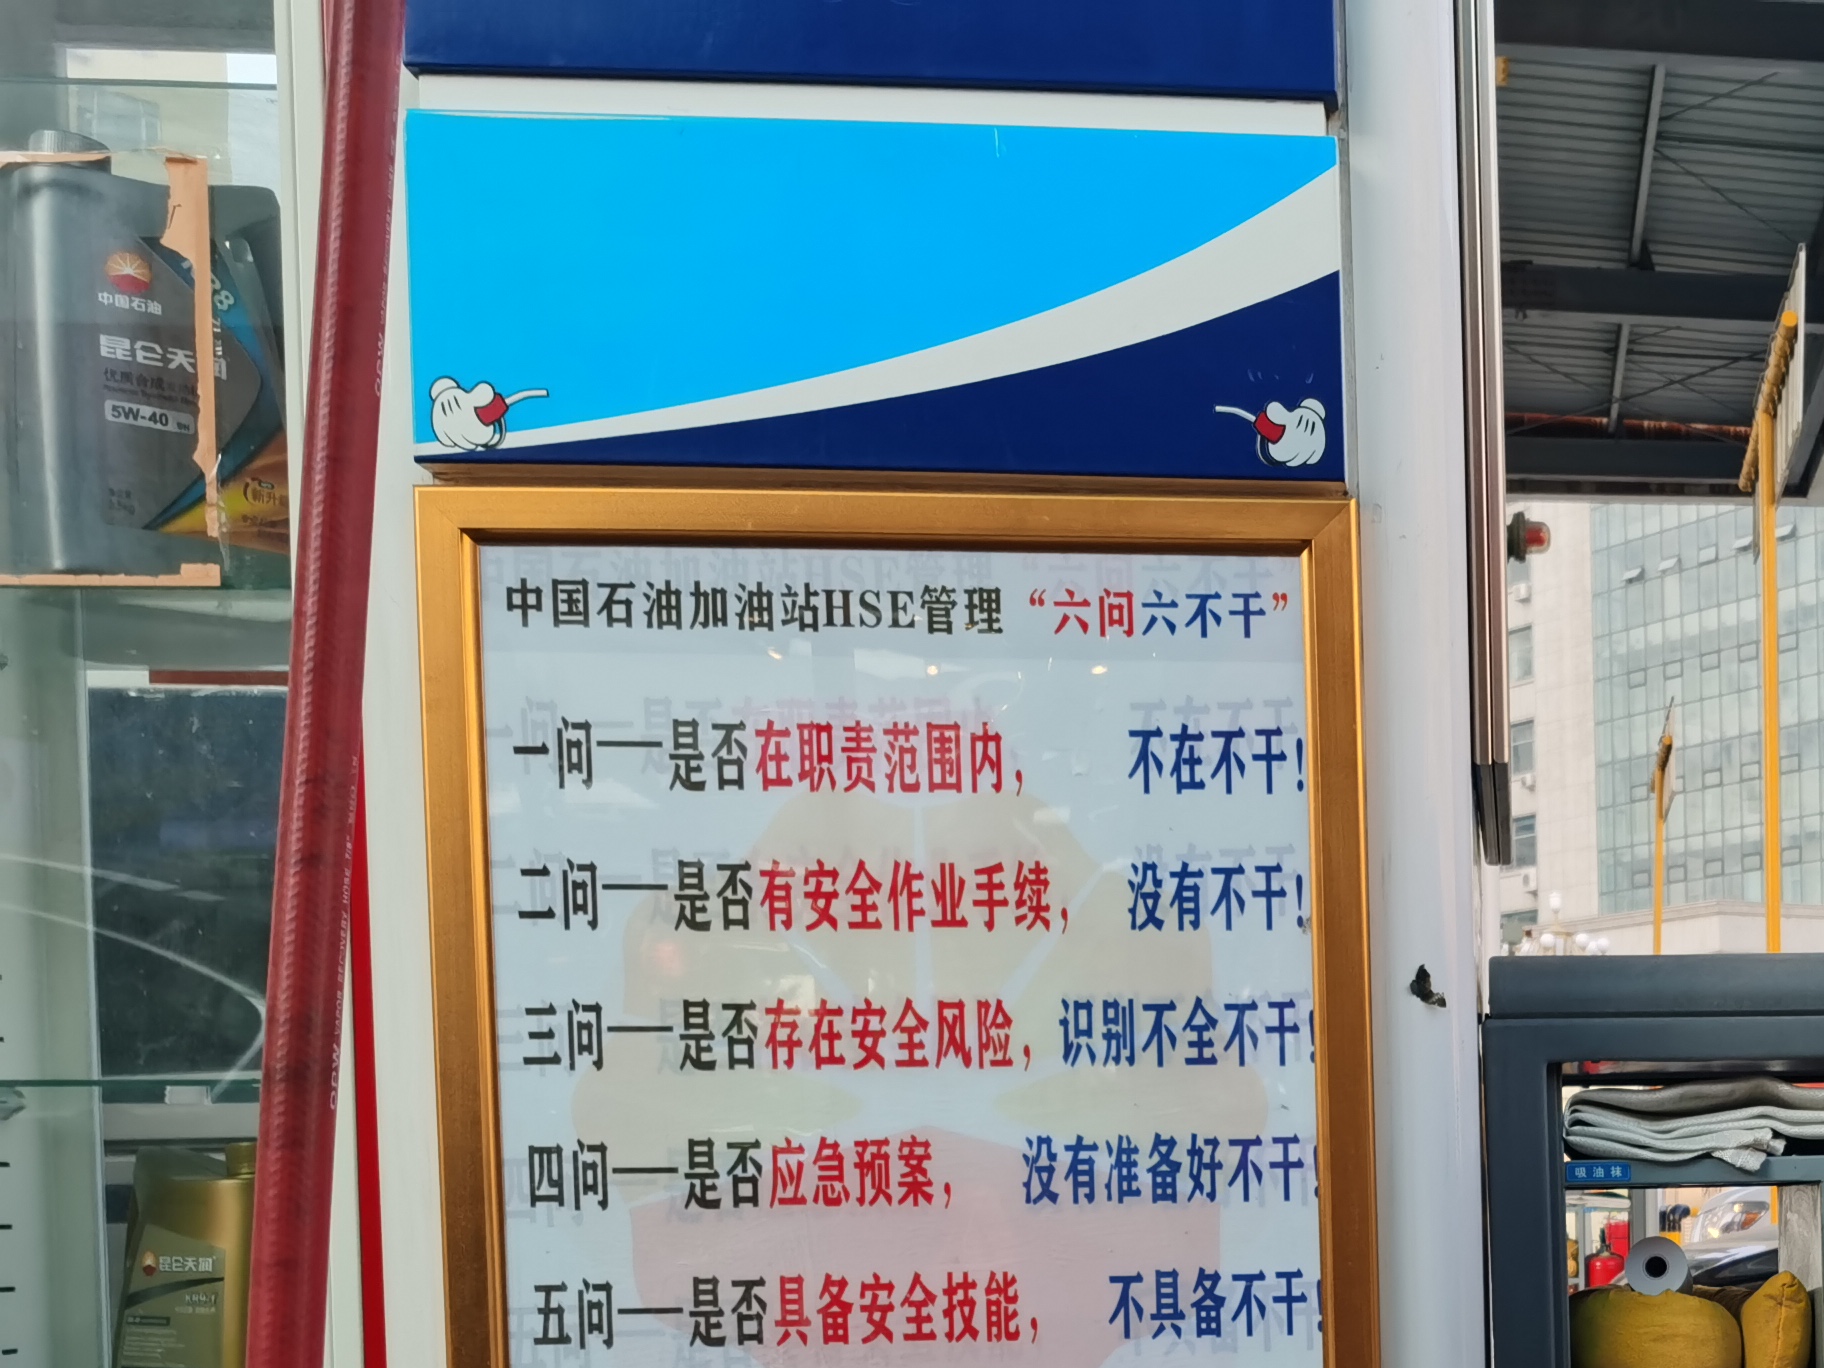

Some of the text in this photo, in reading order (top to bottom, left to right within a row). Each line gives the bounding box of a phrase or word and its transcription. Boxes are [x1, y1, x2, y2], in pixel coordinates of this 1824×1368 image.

[98, 291, 162, 316] 中国石油
[111, 404, 169, 426] 5W-40
[159, 1256, 212, 1272] 昆仑天润
